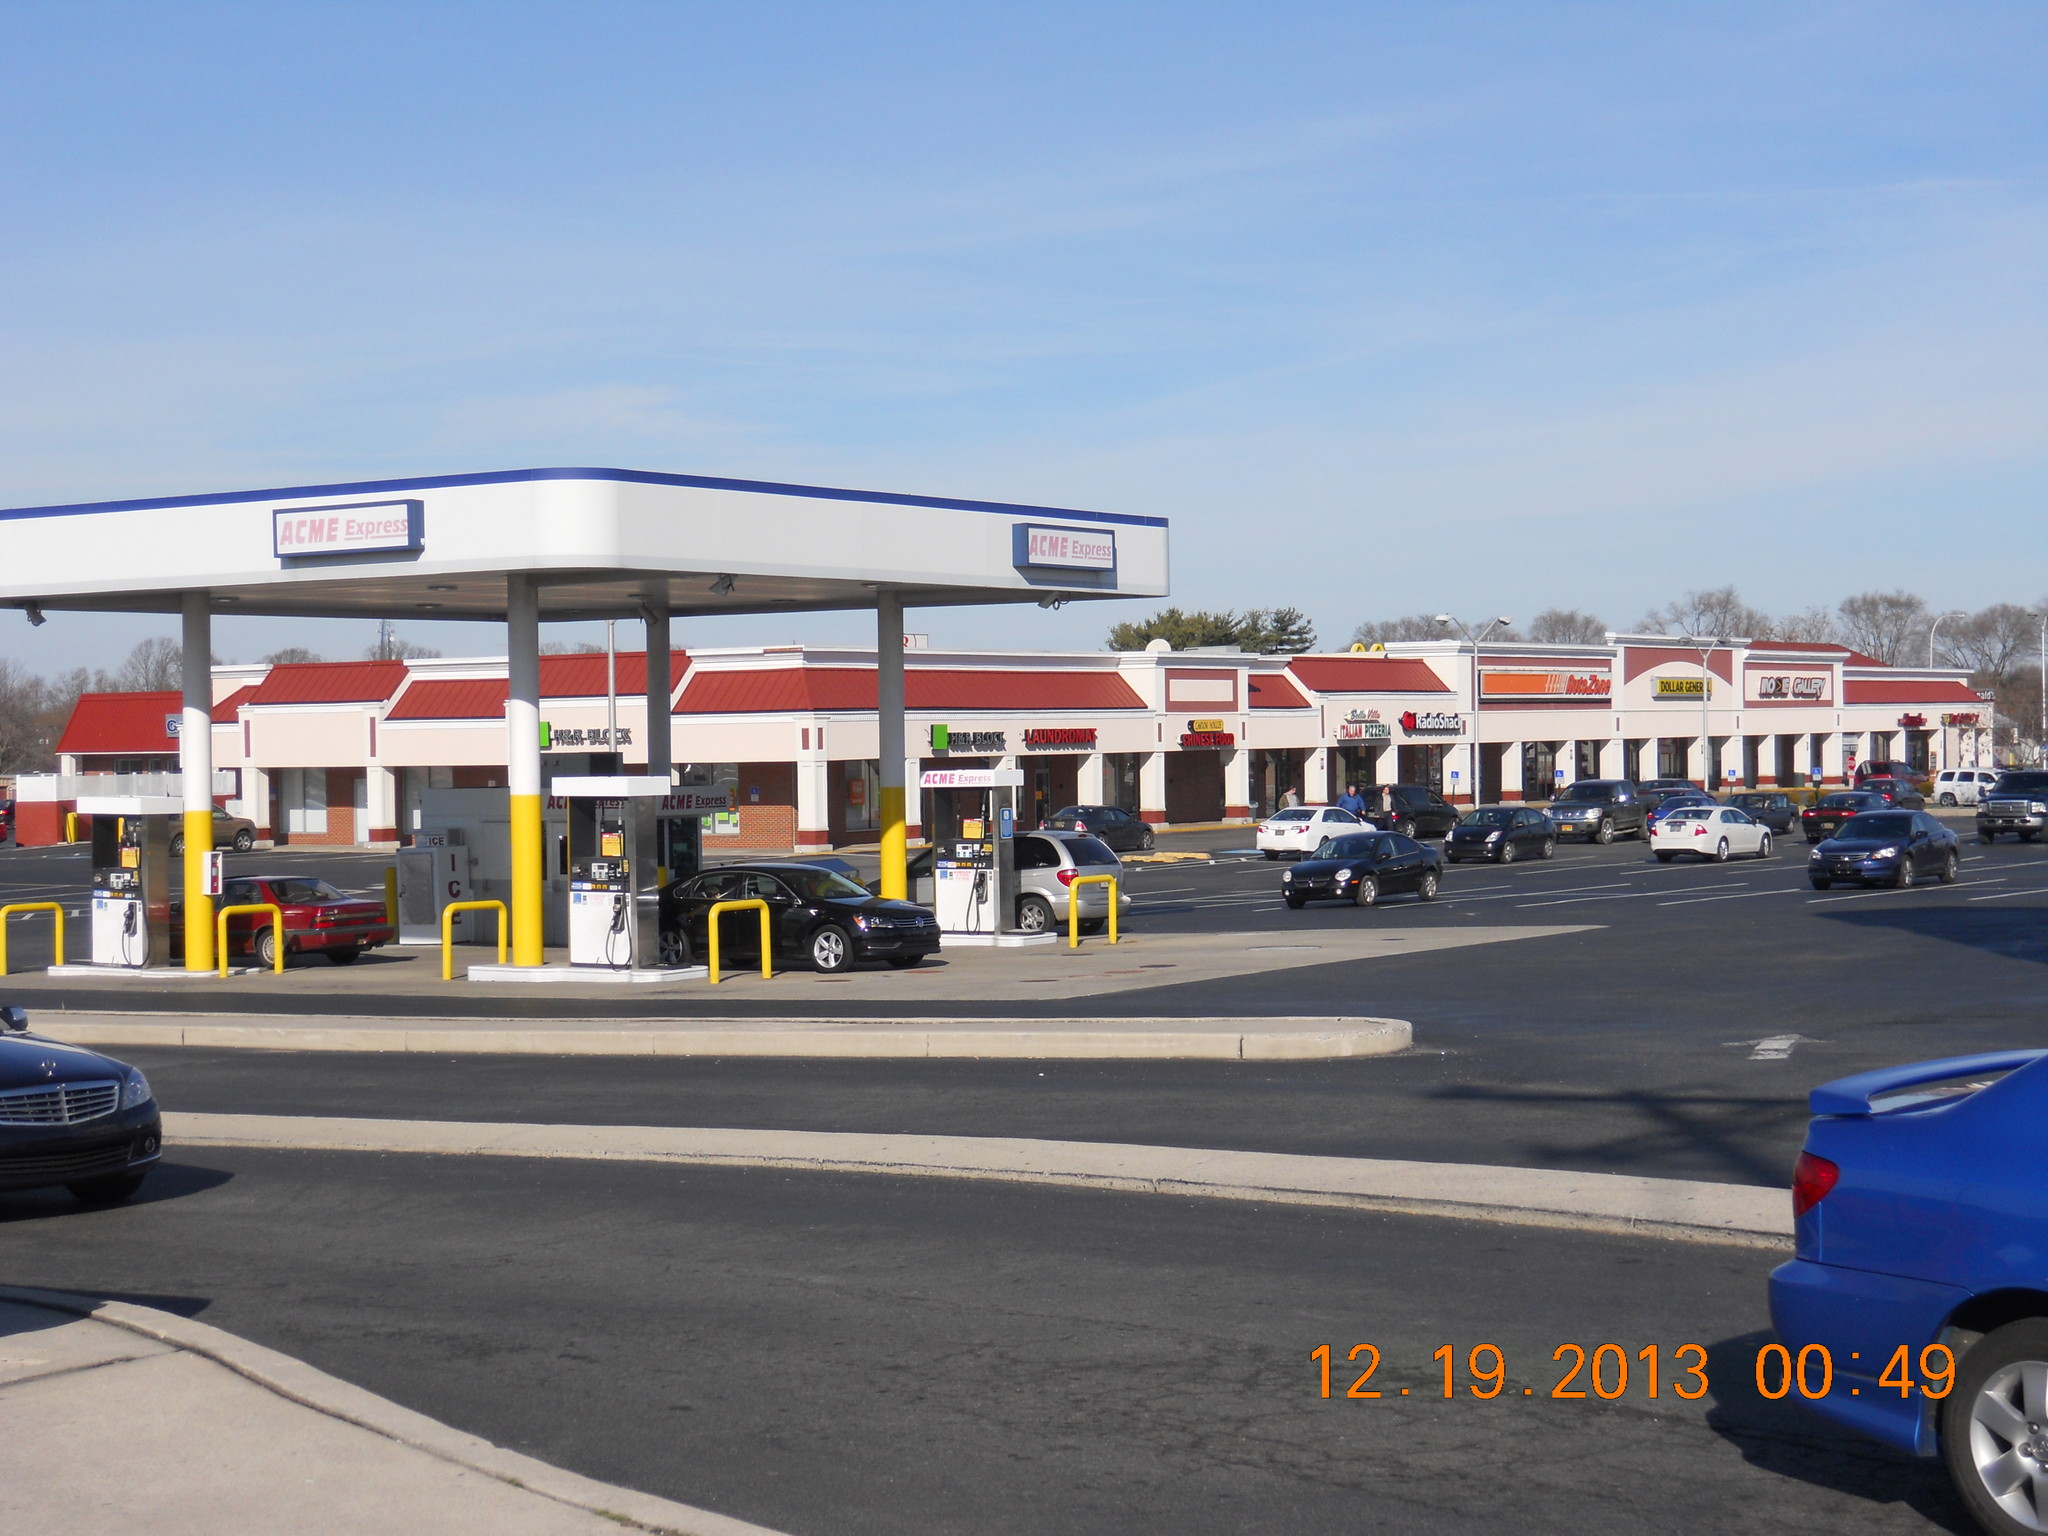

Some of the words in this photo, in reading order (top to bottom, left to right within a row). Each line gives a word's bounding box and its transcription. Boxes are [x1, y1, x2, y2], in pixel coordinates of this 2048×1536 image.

[280, 517, 339, 545] ACME
[345, 519, 408, 540] Express
[1029, 535, 1068, 558] ACME
[1071, 540, 1112, 559] Express
[1566, 674, 1611, 693] AutoZone
[1661, 681, 1684, 692] DOLLAR
[1685, 681, 1711, 692] GENERL
[1793, 677, 1826, 699] GALLERY
[553, 729, 583, 742] H&R
[1025, 728, 1098, 745] LAUNDROMAT
[1339, 724, 1362, 739] ITALIAN
[1364, 723, 1392, 738] PIZZERIA
[1182, 734, 1214, 747] CHINESE
[1215, 733, 1235, 746] FOOD
[924, 773, 956, 785] ACME
[957, 774, 992, 785] Express
[661, 795, 693, 810] ACME
[695, 796, 727, 809] Express
[429, 837, 445, 846] ICE
